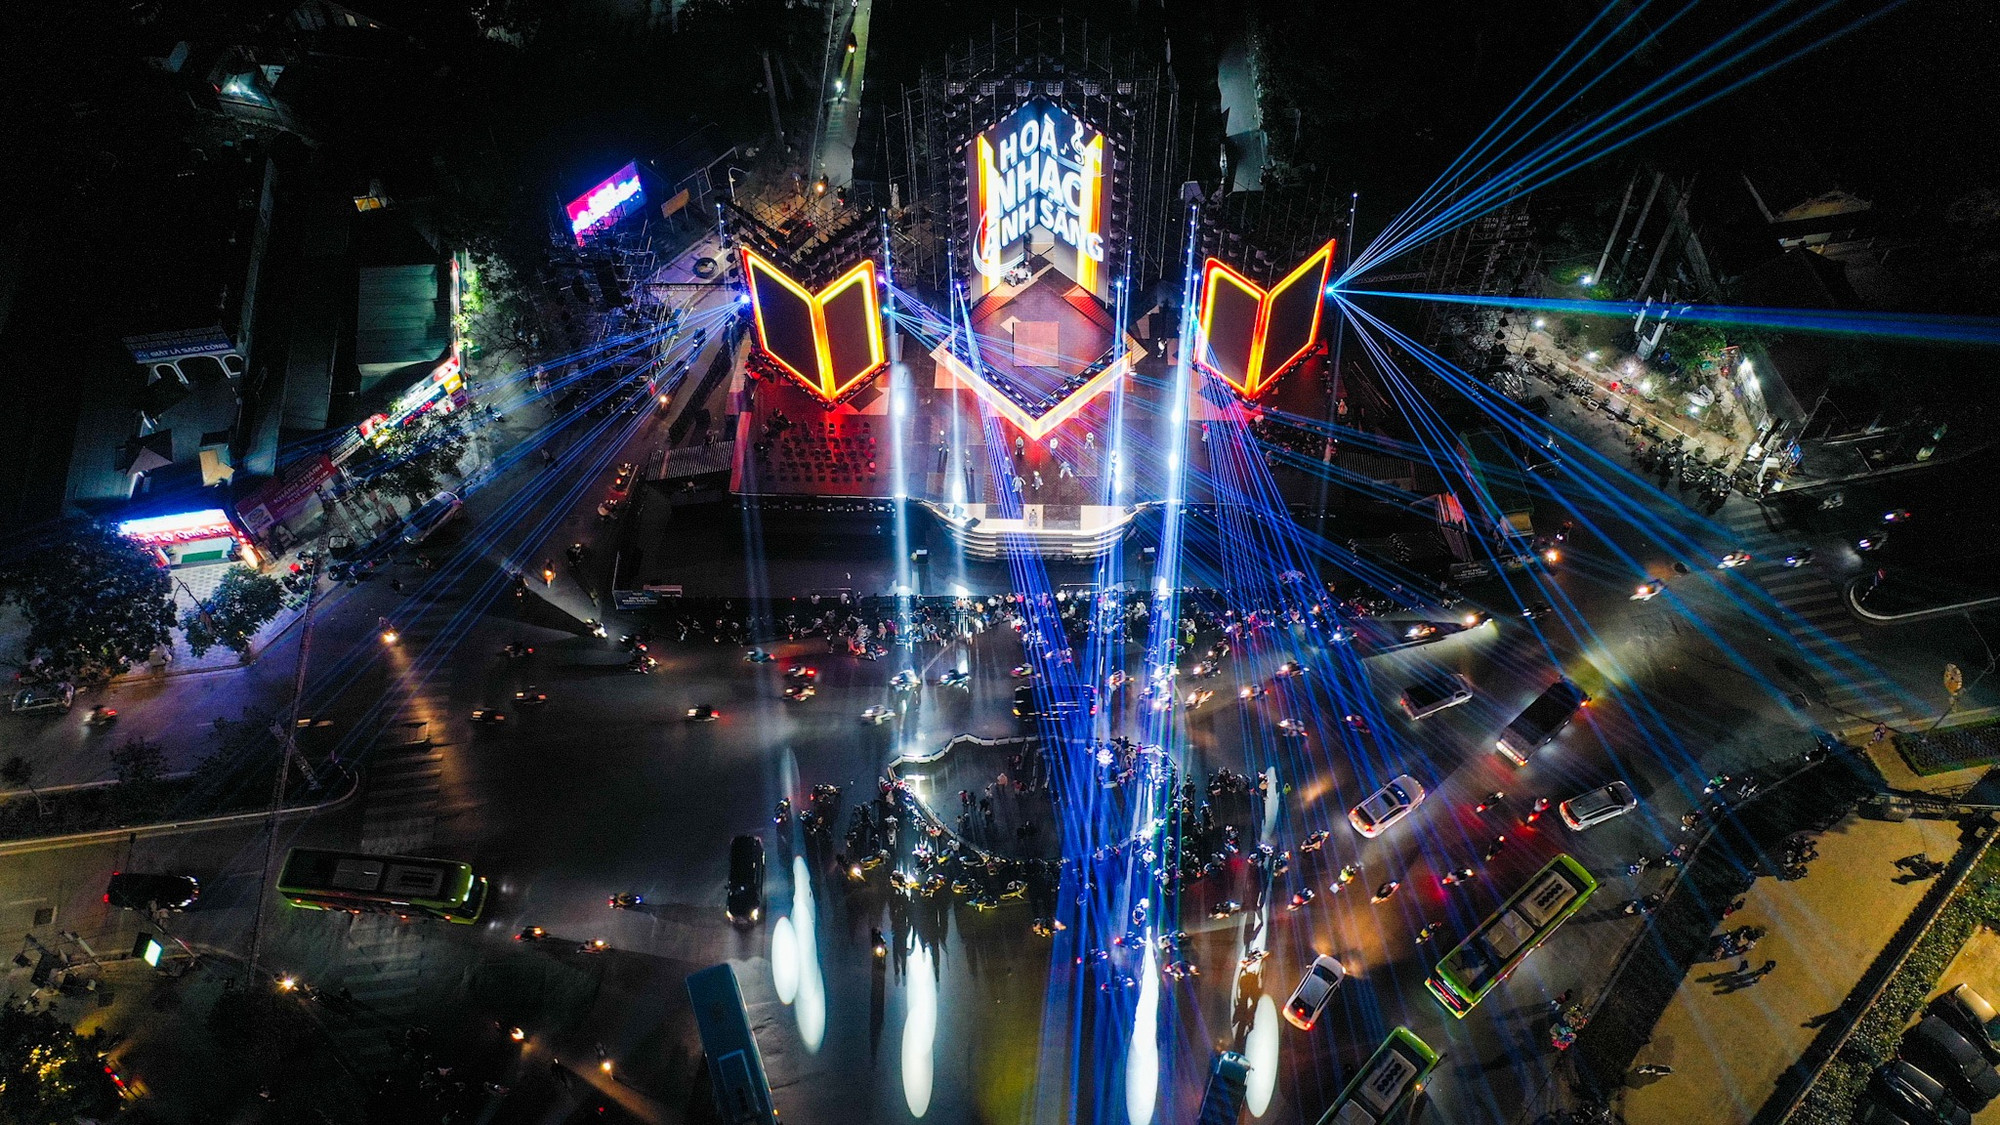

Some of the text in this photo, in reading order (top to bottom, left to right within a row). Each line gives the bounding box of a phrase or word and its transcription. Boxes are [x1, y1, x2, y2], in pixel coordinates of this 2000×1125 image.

[987, 151, 1085, 218] NHẠC
[983, 198, 1104, 262] ÁNH SÁNG
